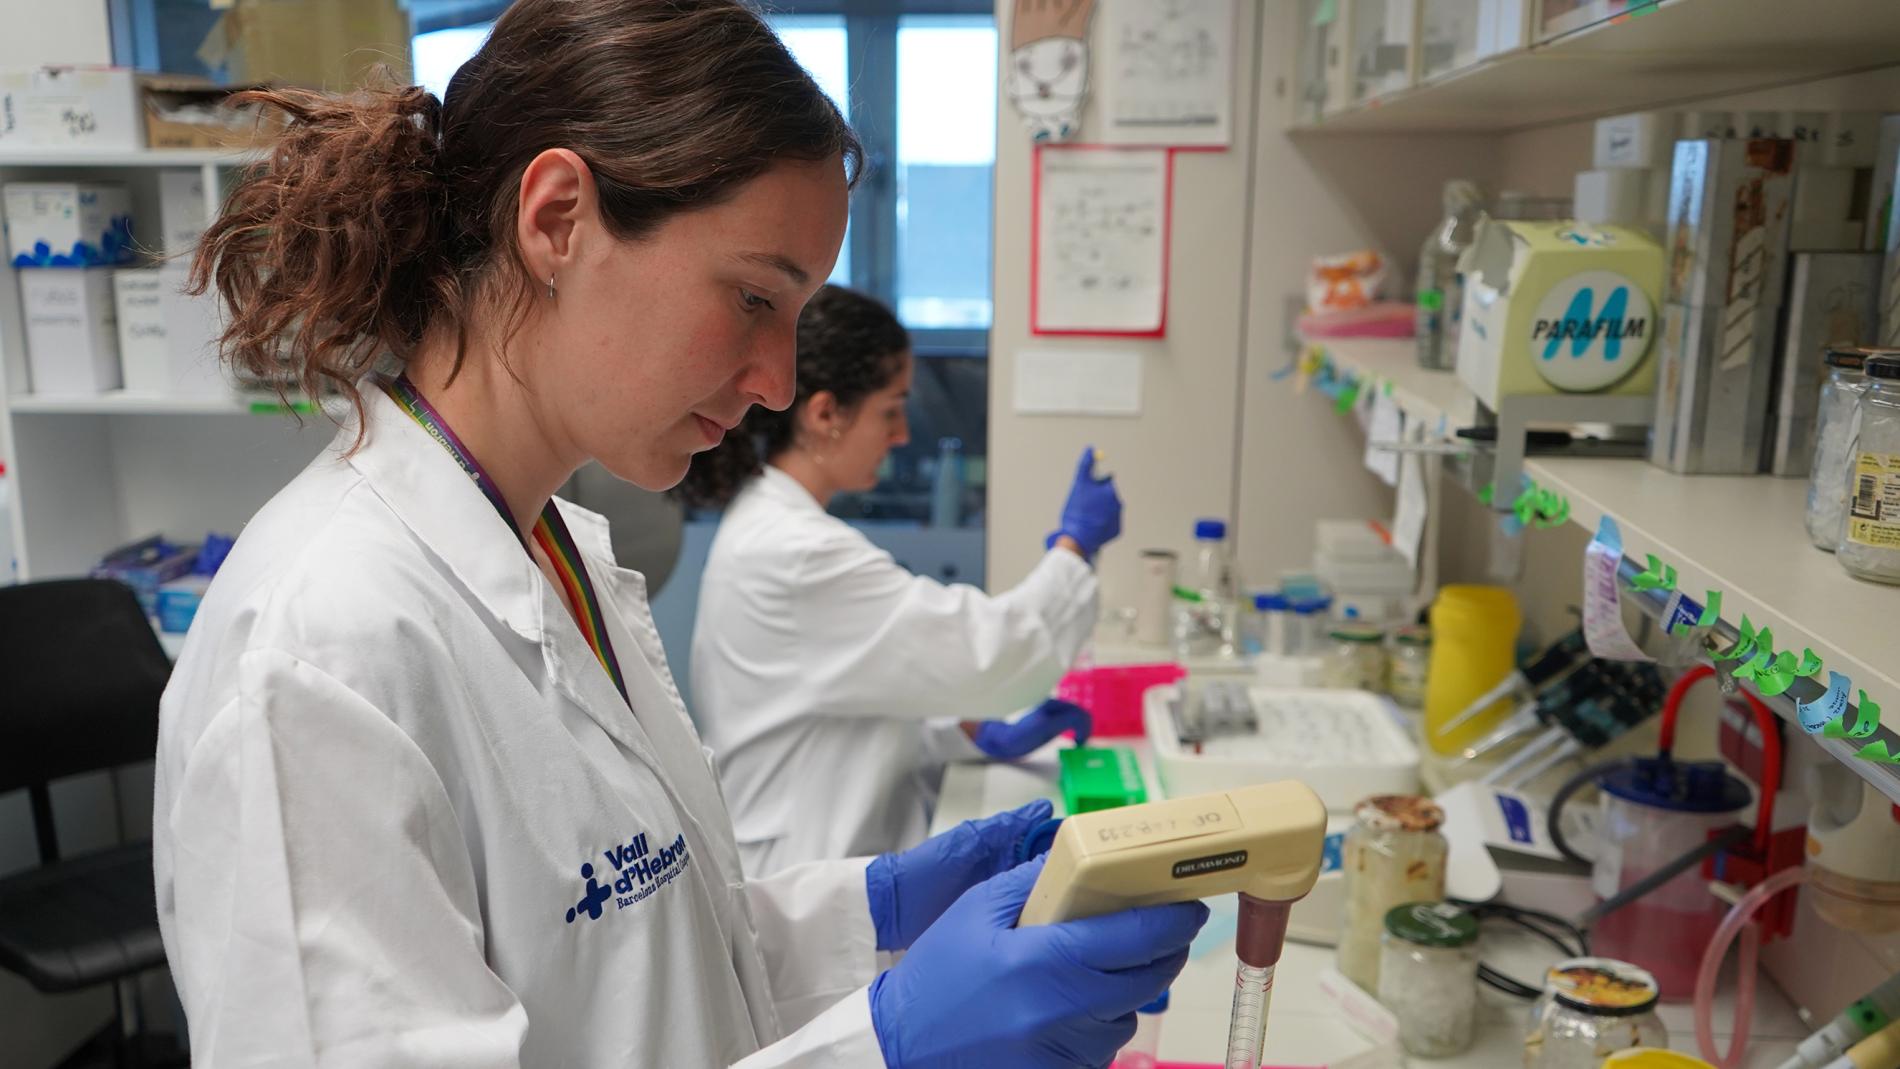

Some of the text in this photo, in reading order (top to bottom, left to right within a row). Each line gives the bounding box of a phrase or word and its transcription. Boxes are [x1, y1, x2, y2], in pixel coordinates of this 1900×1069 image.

[1531, 317, 1646, 341] PARAFILM
[604, 832, 649, 871] Vall
[615, 833, 686, 894] d'Hebron
[1175, 855, 1246, 875] DRUMMOND
[615, 885, 657, 910] Barcelona
[655, 862, 682, 888] Hospital
